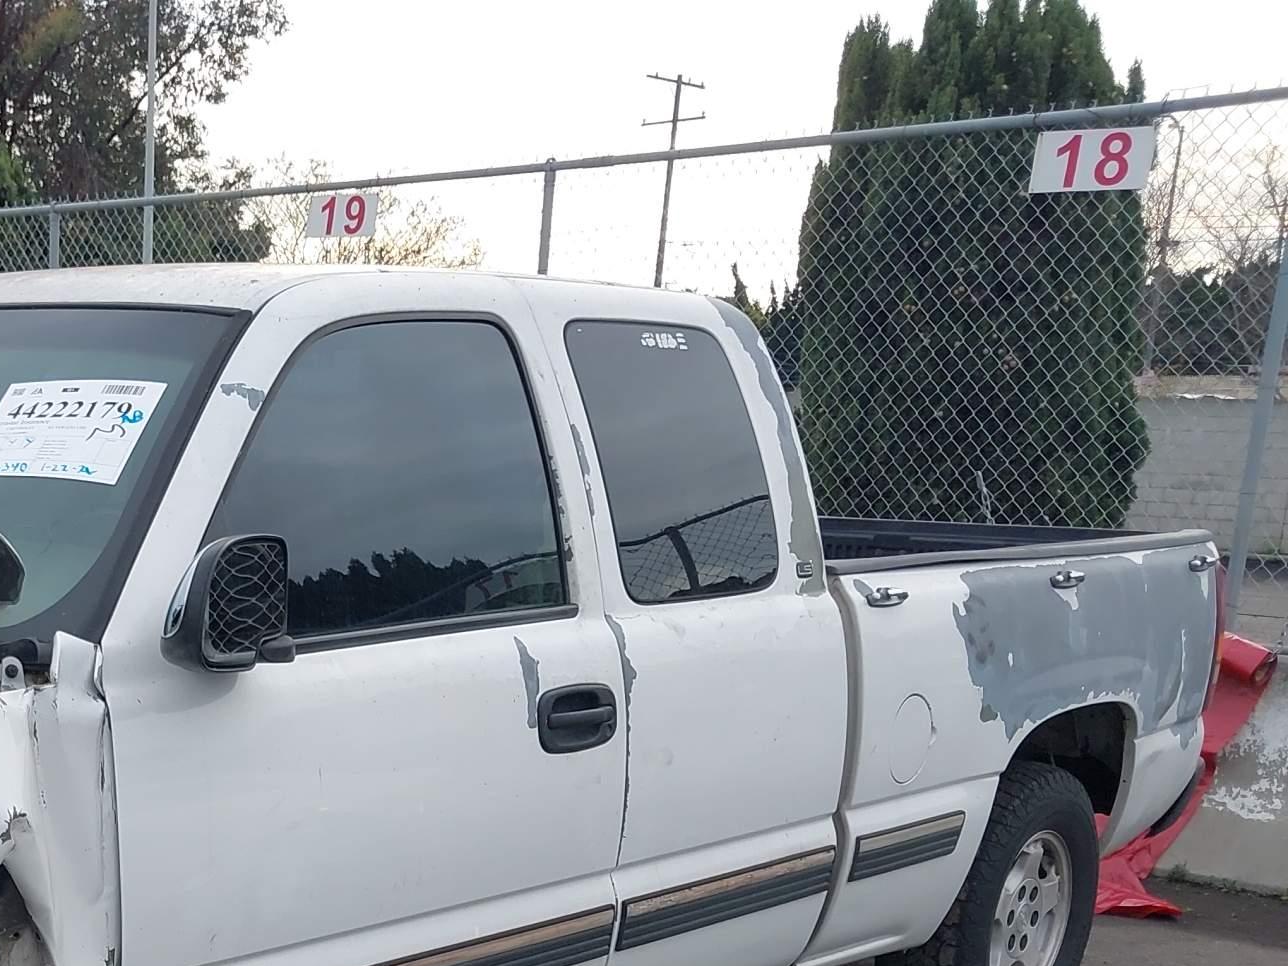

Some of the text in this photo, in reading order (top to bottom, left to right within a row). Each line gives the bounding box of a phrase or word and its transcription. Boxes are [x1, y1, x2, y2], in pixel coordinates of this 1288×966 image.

[1056, 131, 1133, 188] 18
[320, 195, 366, 236] 19
[7, 400, 133, 420] 44222179
